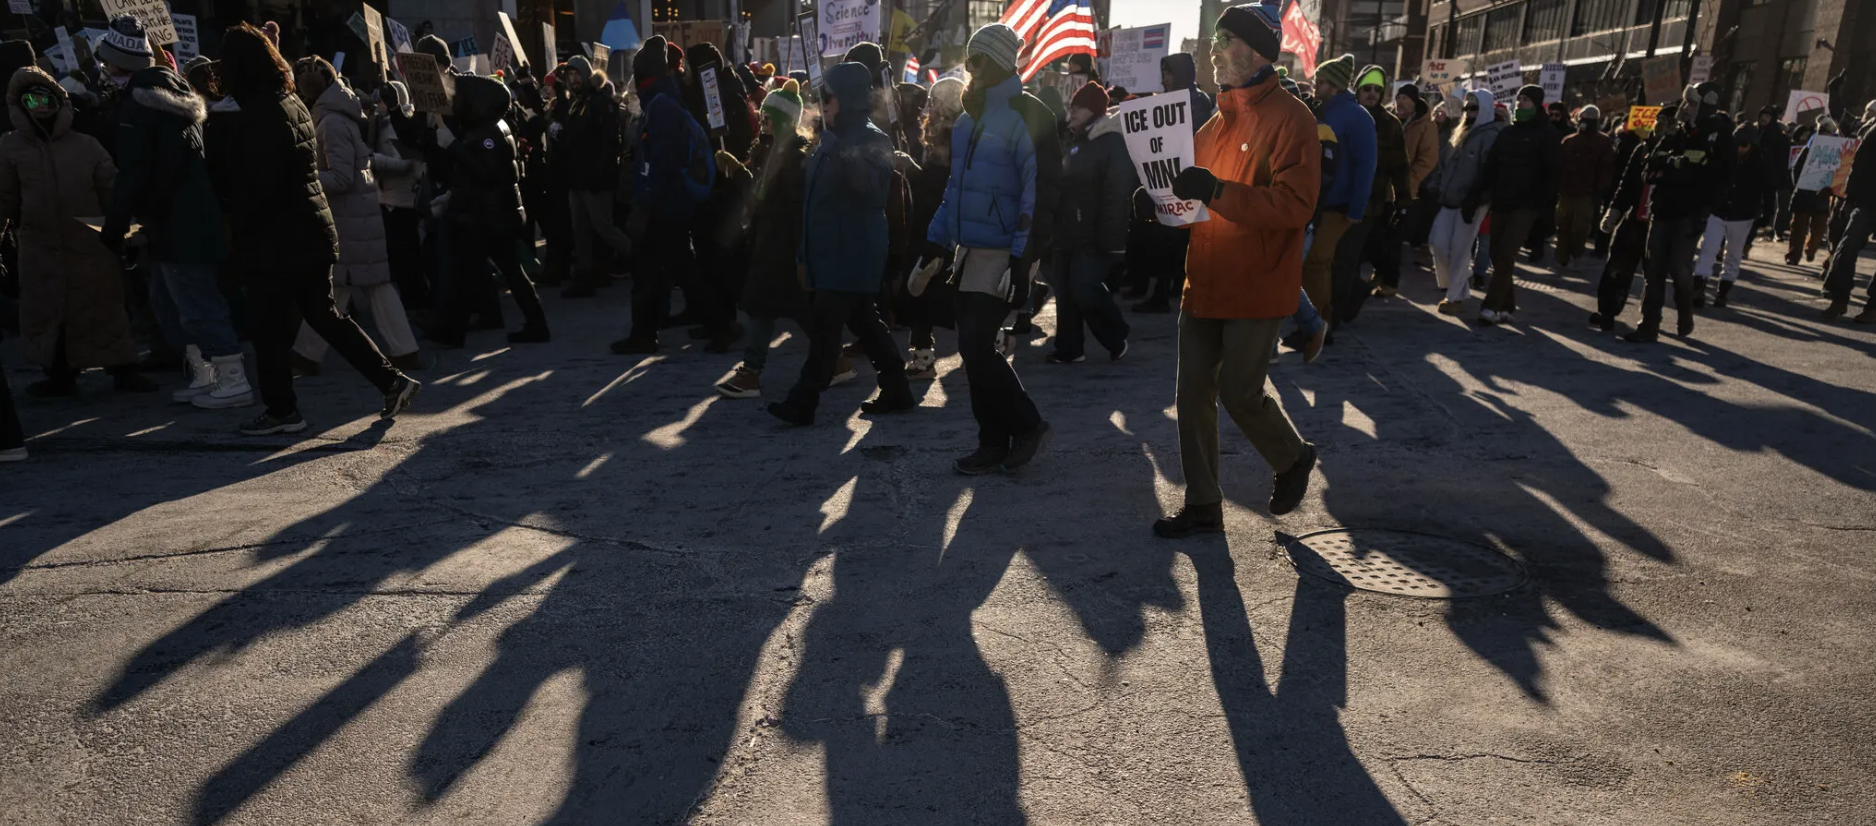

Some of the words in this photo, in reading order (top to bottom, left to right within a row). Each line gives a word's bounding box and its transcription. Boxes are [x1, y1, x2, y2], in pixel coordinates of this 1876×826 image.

[825, 2, 870, 24] Science
[1124, 109, 1149, 134] ICE
[1152, 101, 1187, 129] OUT
[1633, 108, 1659, 120] ICE
[1149, 136, 1164, 154] OF
[1156, 201, 1194, 217] MIRAC
